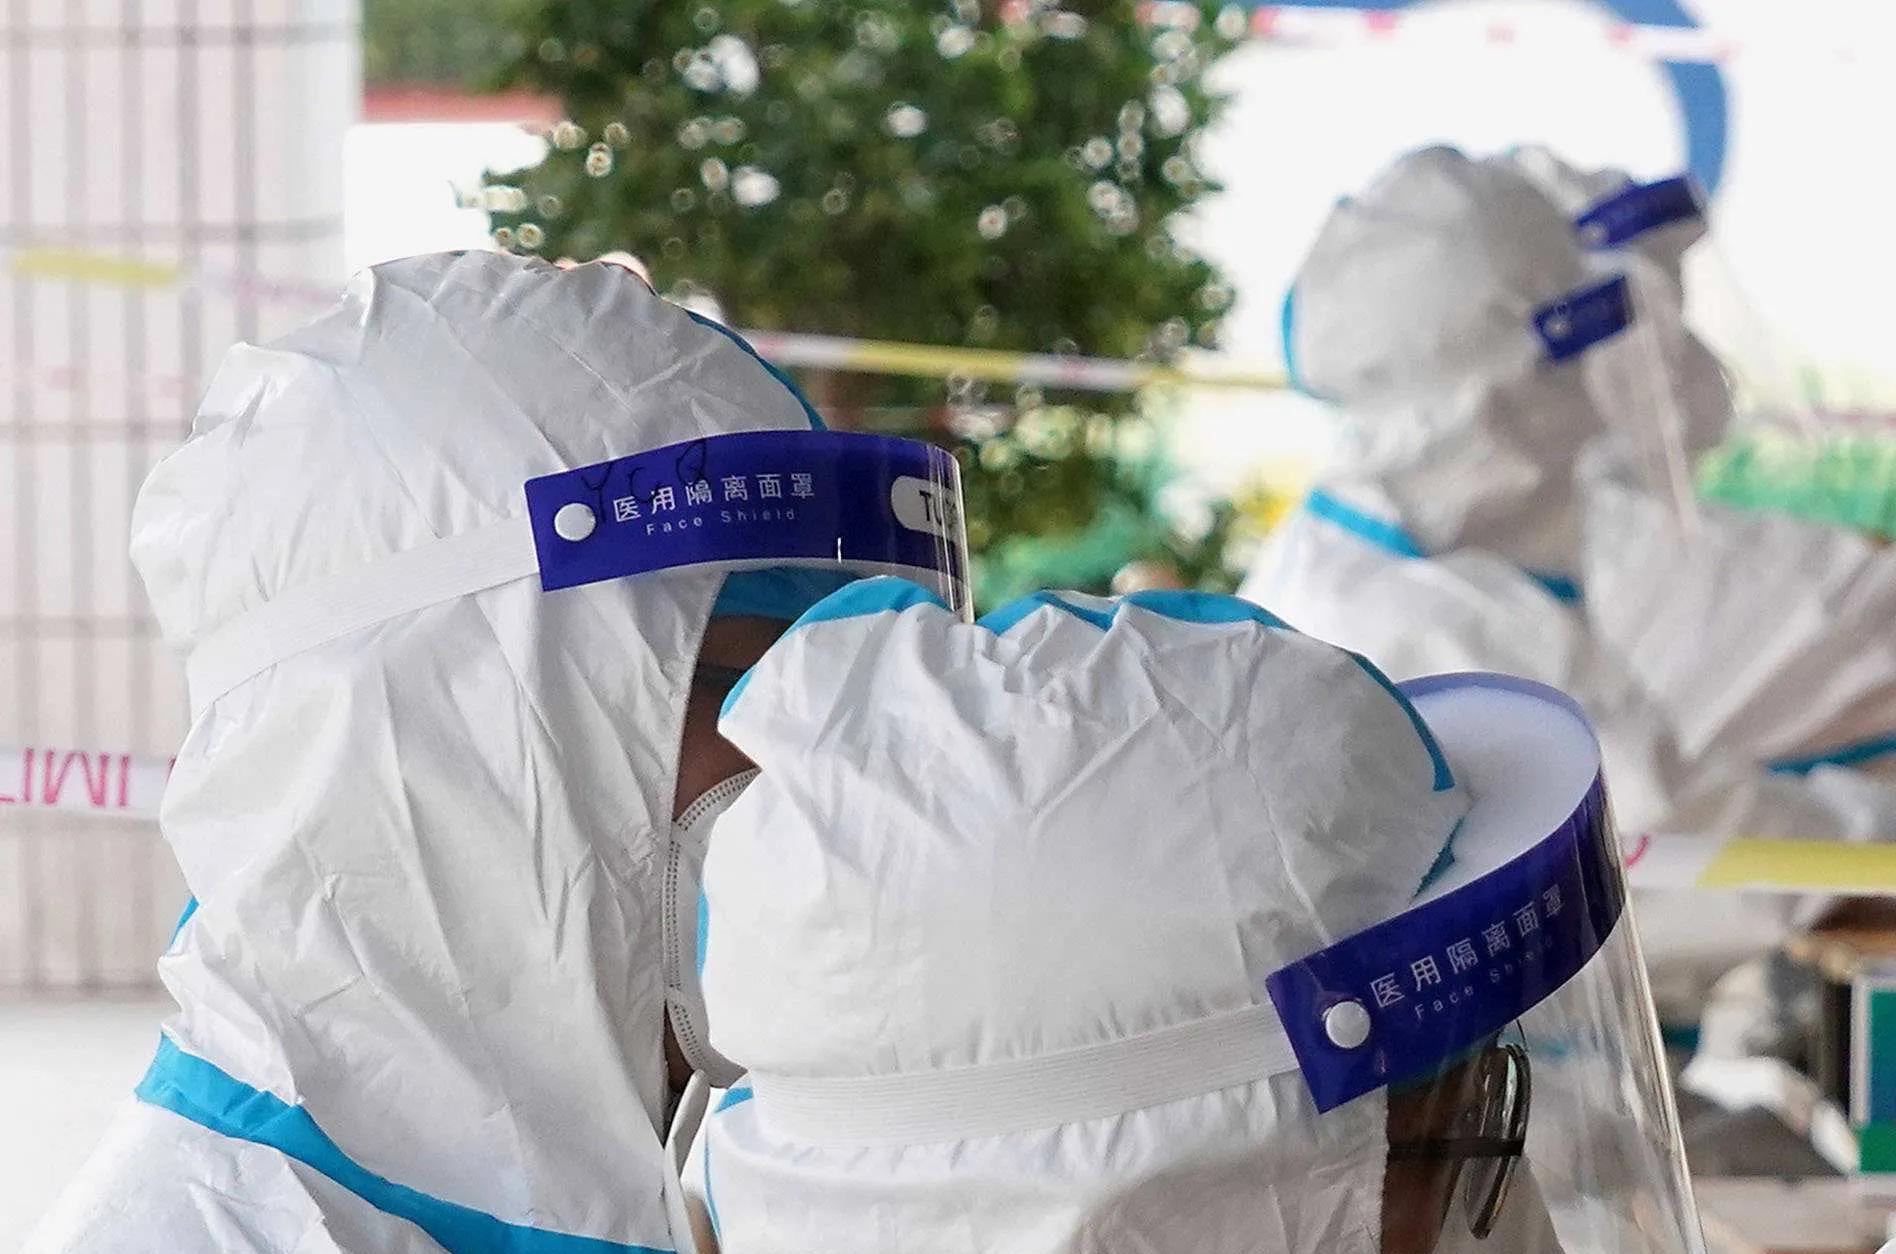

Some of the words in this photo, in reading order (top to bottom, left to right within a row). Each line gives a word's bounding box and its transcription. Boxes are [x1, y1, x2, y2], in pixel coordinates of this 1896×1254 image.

[613, 472, 816, 523] 医用隔离面罩
[646, 515, 703, 536] Face
[720, 508, 797, 524] Shield
[1370, 883, 1566, 1009] 医用隔离面罩
[1415, 985, 1474, 1021] Face
[1489, 938, 1553, 983] Shied
